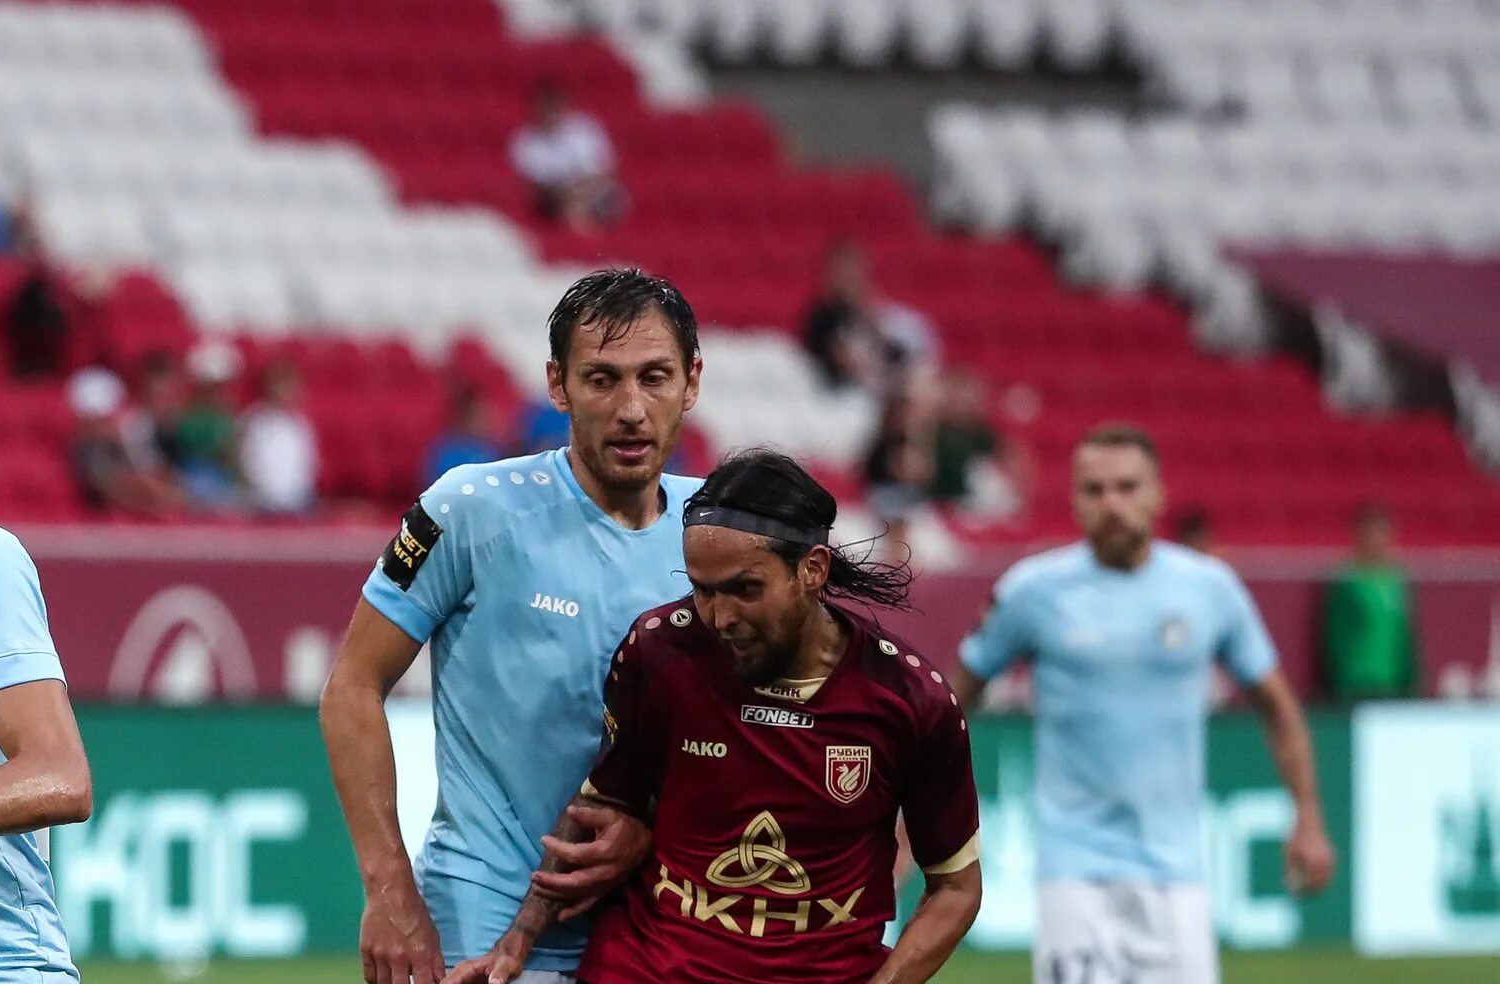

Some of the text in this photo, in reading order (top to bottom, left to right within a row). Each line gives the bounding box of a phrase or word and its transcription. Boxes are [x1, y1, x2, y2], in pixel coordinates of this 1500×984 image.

[530, 592, 580, 617] JAKO
[743, 707, 812, 726] FONBET
[681, 738, 728, 758] JAKO
[828, 747, 870, 757] РУБИН
